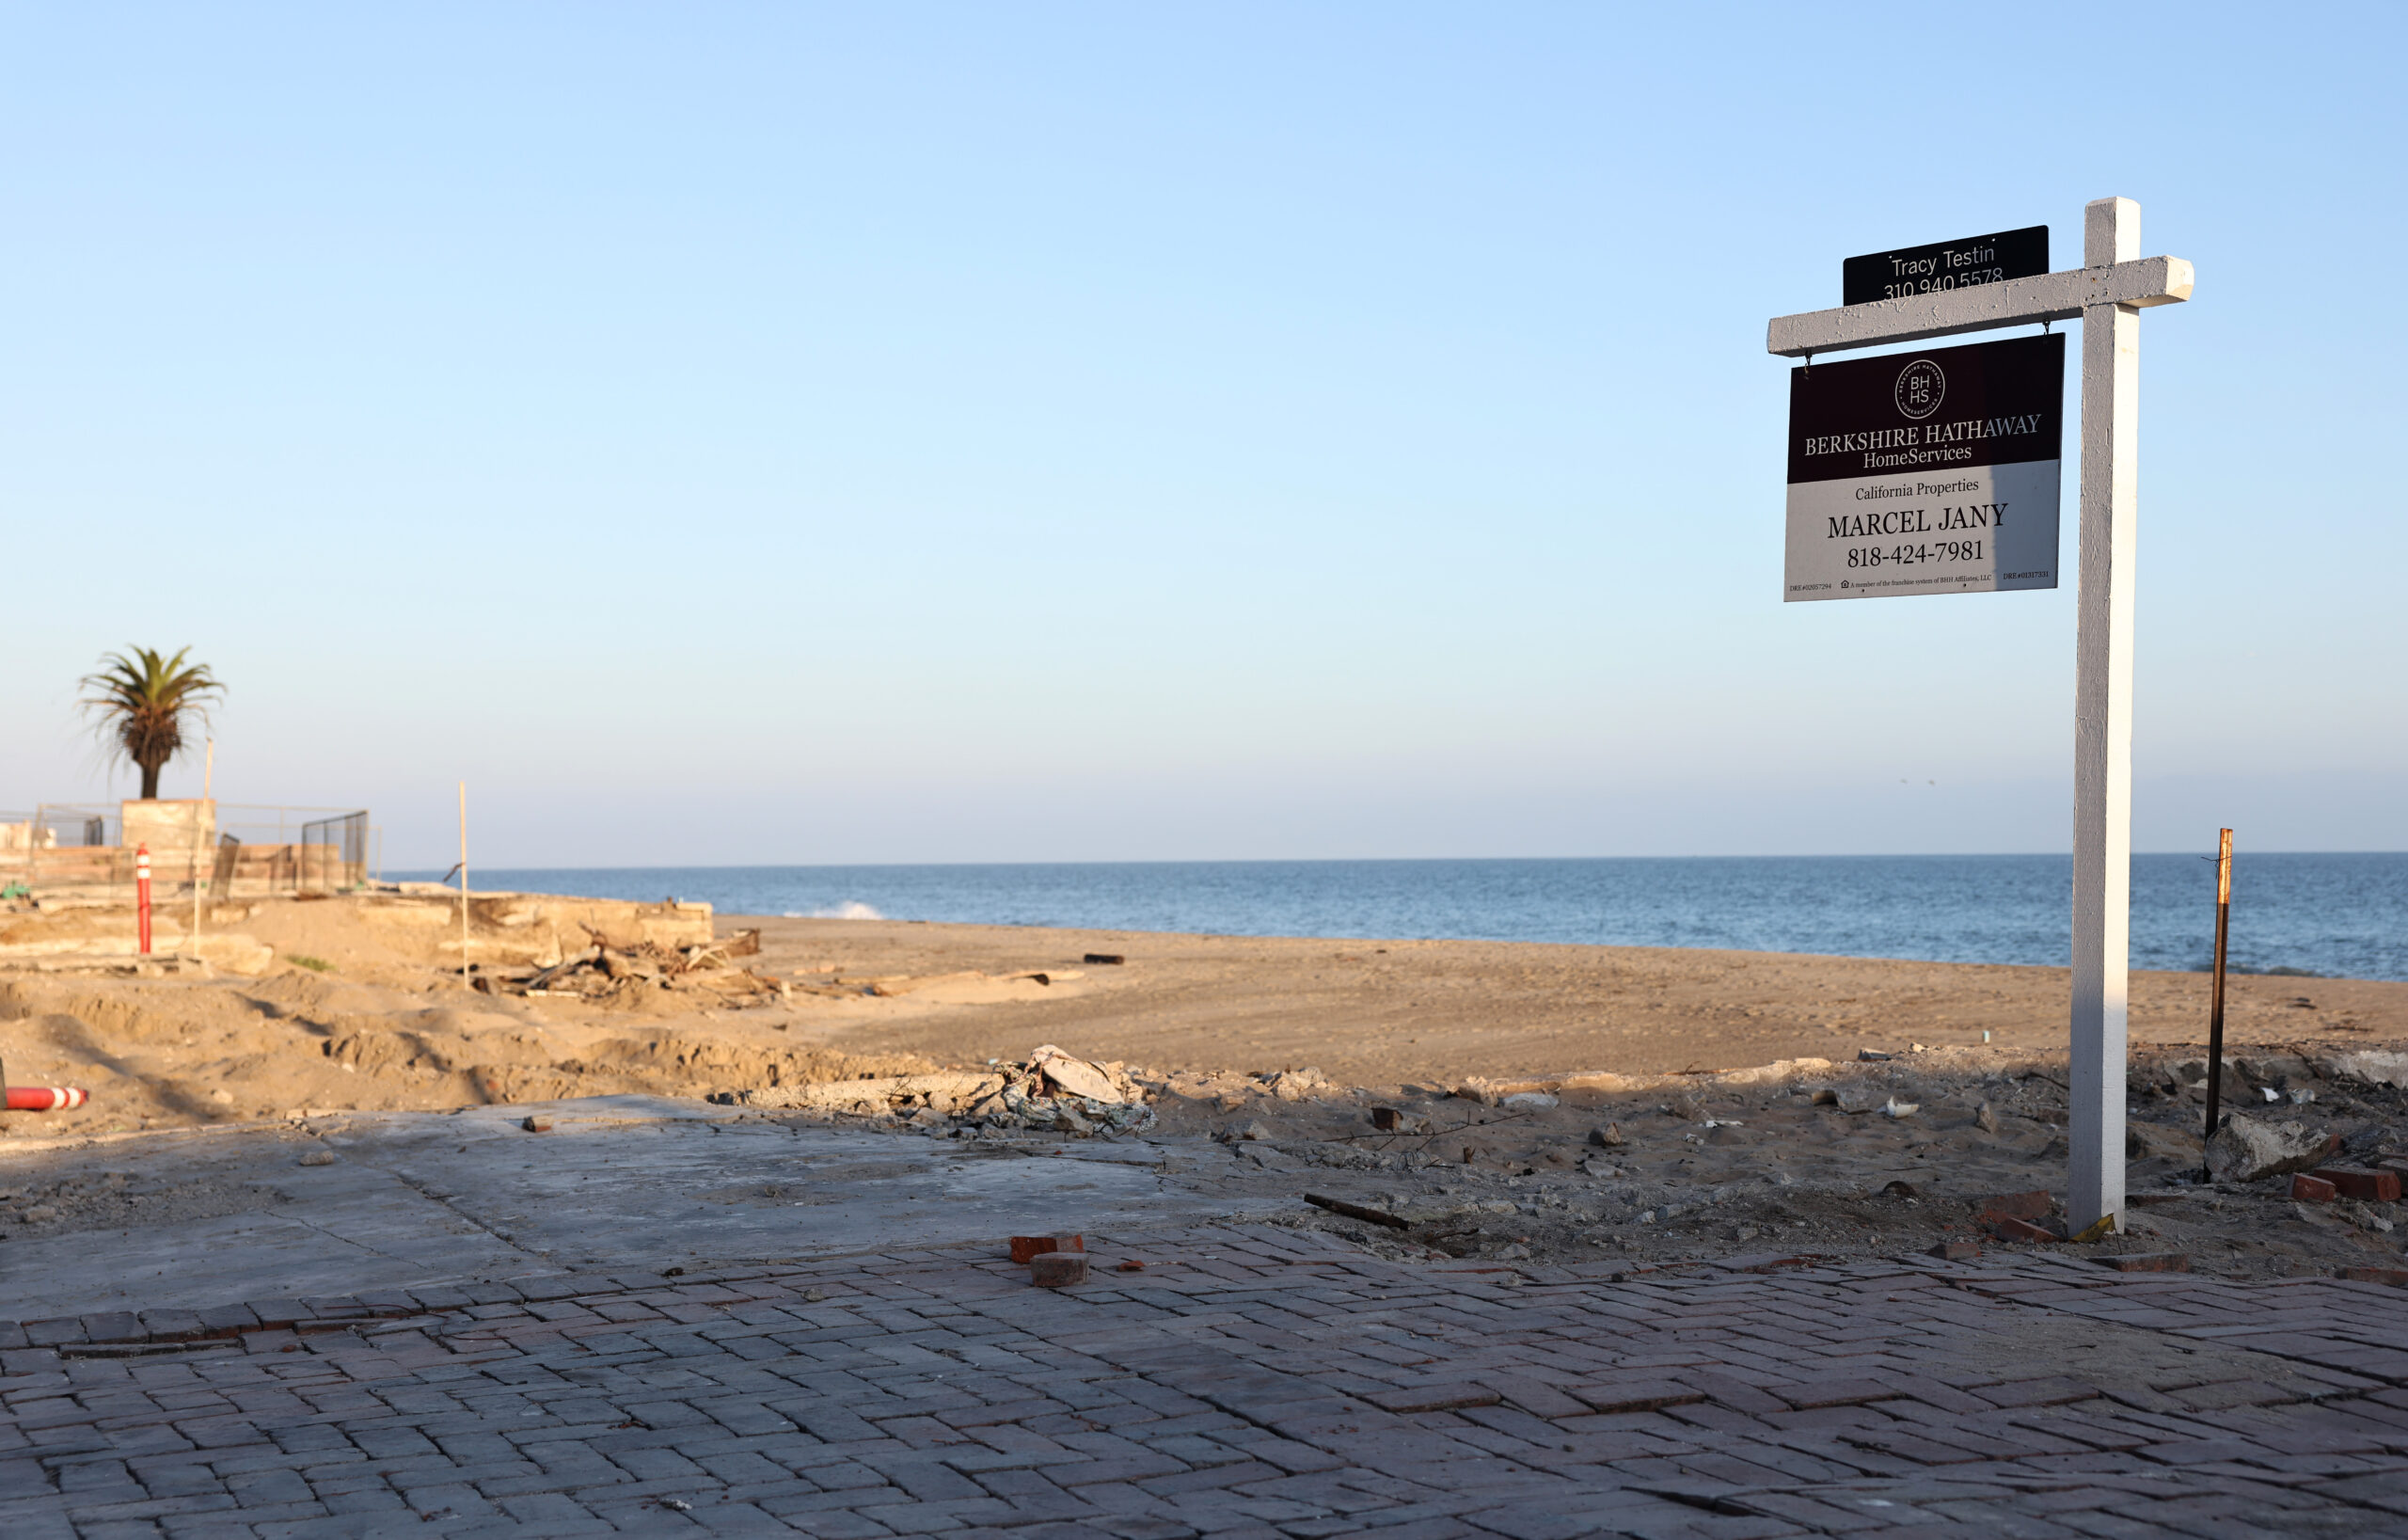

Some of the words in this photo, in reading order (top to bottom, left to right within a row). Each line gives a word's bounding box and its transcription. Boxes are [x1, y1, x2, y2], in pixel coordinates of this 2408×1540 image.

[1892, 258, 1938, 277] Tracy
[1943, 246, 1995, 269] Testin
[1884, 281, 1914, 300] 310
[1920, 275, 1955, 294] 940
[1960, 267, 2004, 288] 5578
[1910, 374, 1930, 389] BH
[1909, 389, 1929, 405] HS
[1805, 426, 1919, 456] BERKSHIRE
[1925, 414, 2042, 444] HATHAWAY
[1862, 444, 1972, 468] HomeServices
[1855, 484, 1913, 500] California
[1916, 478, 1979, 499] Properties
[1827, 509, 1931, 539] MARCEL
[1938, 502, 2009, 531] JANY
[1847, 540, 1984, 568] 818-424-7981
